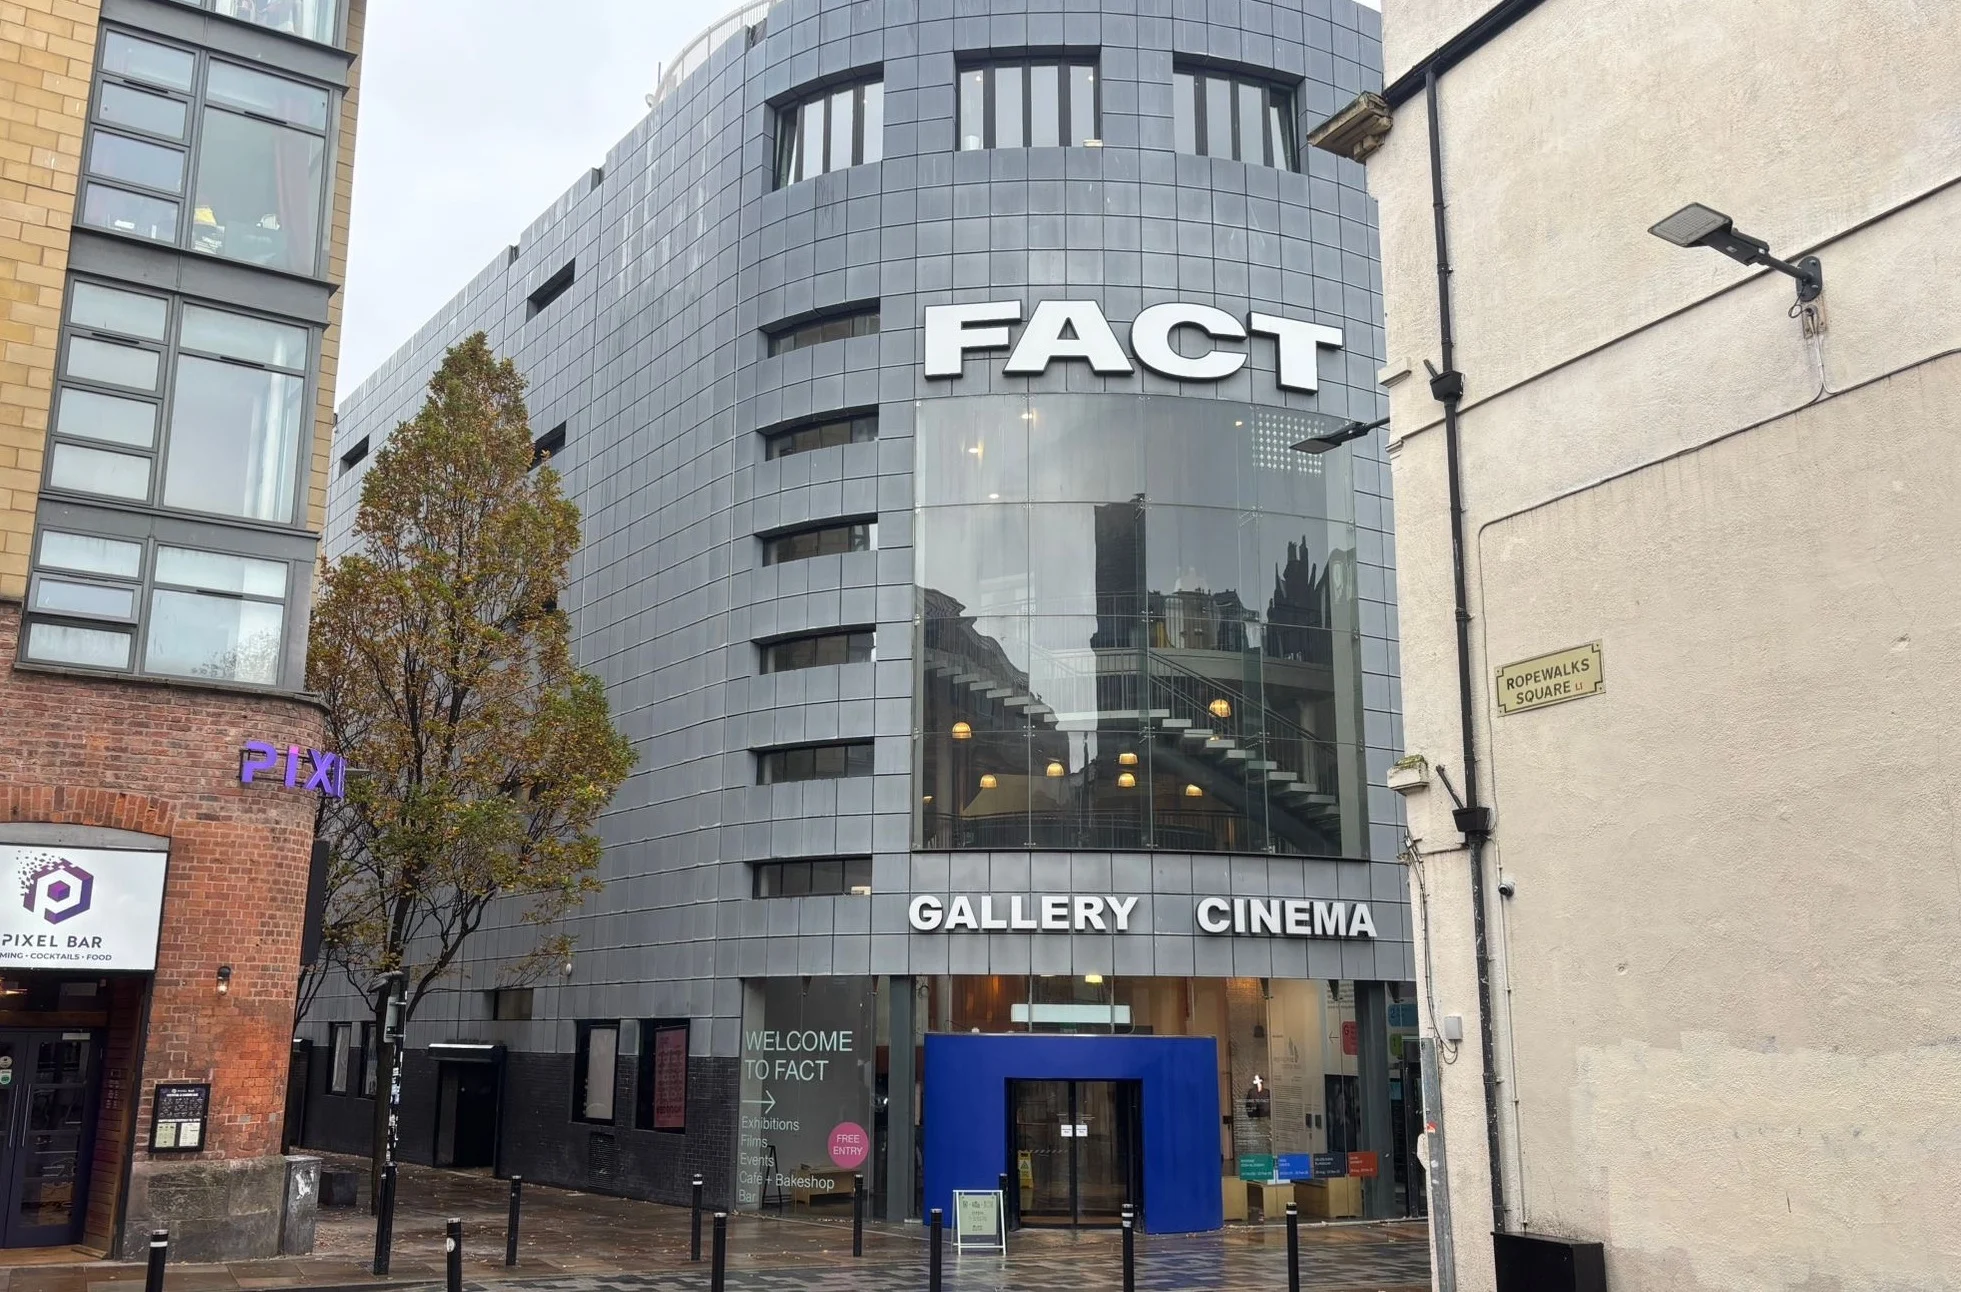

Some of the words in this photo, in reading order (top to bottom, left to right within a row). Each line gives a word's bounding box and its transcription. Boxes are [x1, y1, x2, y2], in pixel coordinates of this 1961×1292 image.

[924, 299, 1344, 395] FACT
[1506, 658, 1590, 690] ROPEWALKS
[1516, 680, 1571, 705] SQUARE
[908, 894, 1139, 931] GALLERY
[1196, 896, 1378, 939] CINEMA
[2, 933, 58, 947] PIXEL
[67, 935, 102, 949] BAR
[30, 952, 80, 960] COCKTAILS
[745, 1030, 853, 1052] WELCOME
[744, 1059, 769, 1081] TO
[774, 1059, 829, 1081] FACT
[741, 1116, 800, 1131] Exhibitions
[740, 1134, 767, 1148] Films
[836, 1134, 860, 1144] FREE
[833, 1146, 863, 1156] ENTRY
[740, 1152, 775, 1167] Events
[775, 1173, 835, 1192] Bakeshop
[738, 1189, 756, 1203] Bar
